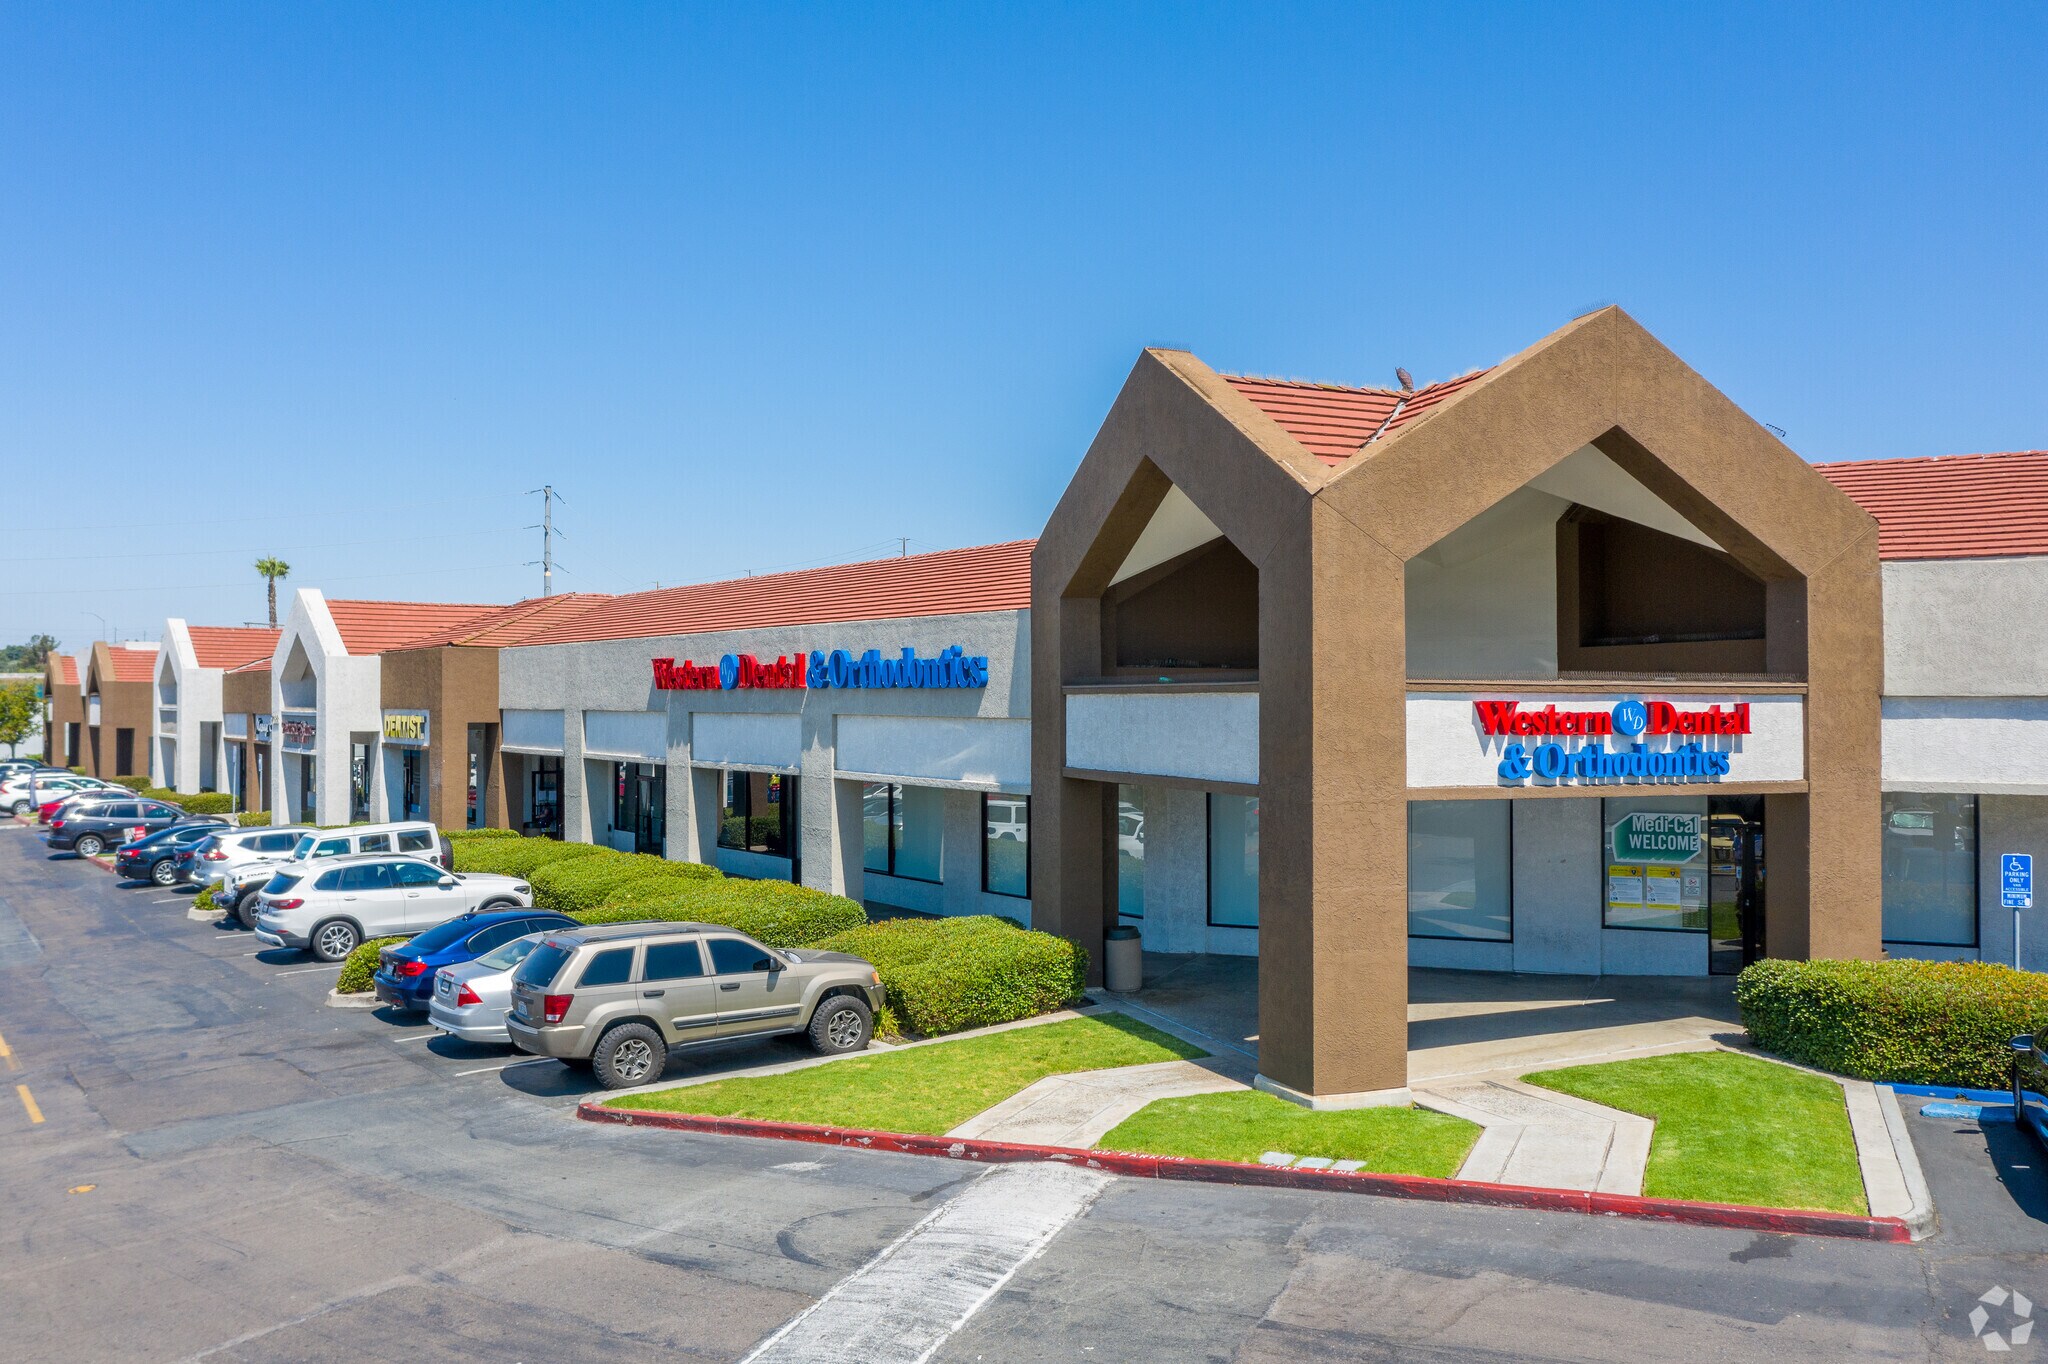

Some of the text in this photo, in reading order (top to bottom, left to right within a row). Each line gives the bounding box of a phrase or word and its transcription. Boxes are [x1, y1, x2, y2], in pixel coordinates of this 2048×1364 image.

[651, 657, 722, 690] Western
[737, 653, 807, 689] Dental
[806, 650, 829, 689] &
[828, 645, 989, 689] Orthodontics
[384, 714, 425, 740] DENTIST
[1473, 700, 1613, 736] Western
[1645, 700, 1752, 735] Dental
[1498, 742, 1730, 780] & Orthodontics
[1632, 815, 1699, 834] Medi-Cal
[1629, 833, 1699, 851] WELCOME
[1119, 1151, 1185, 1162] PARKING
